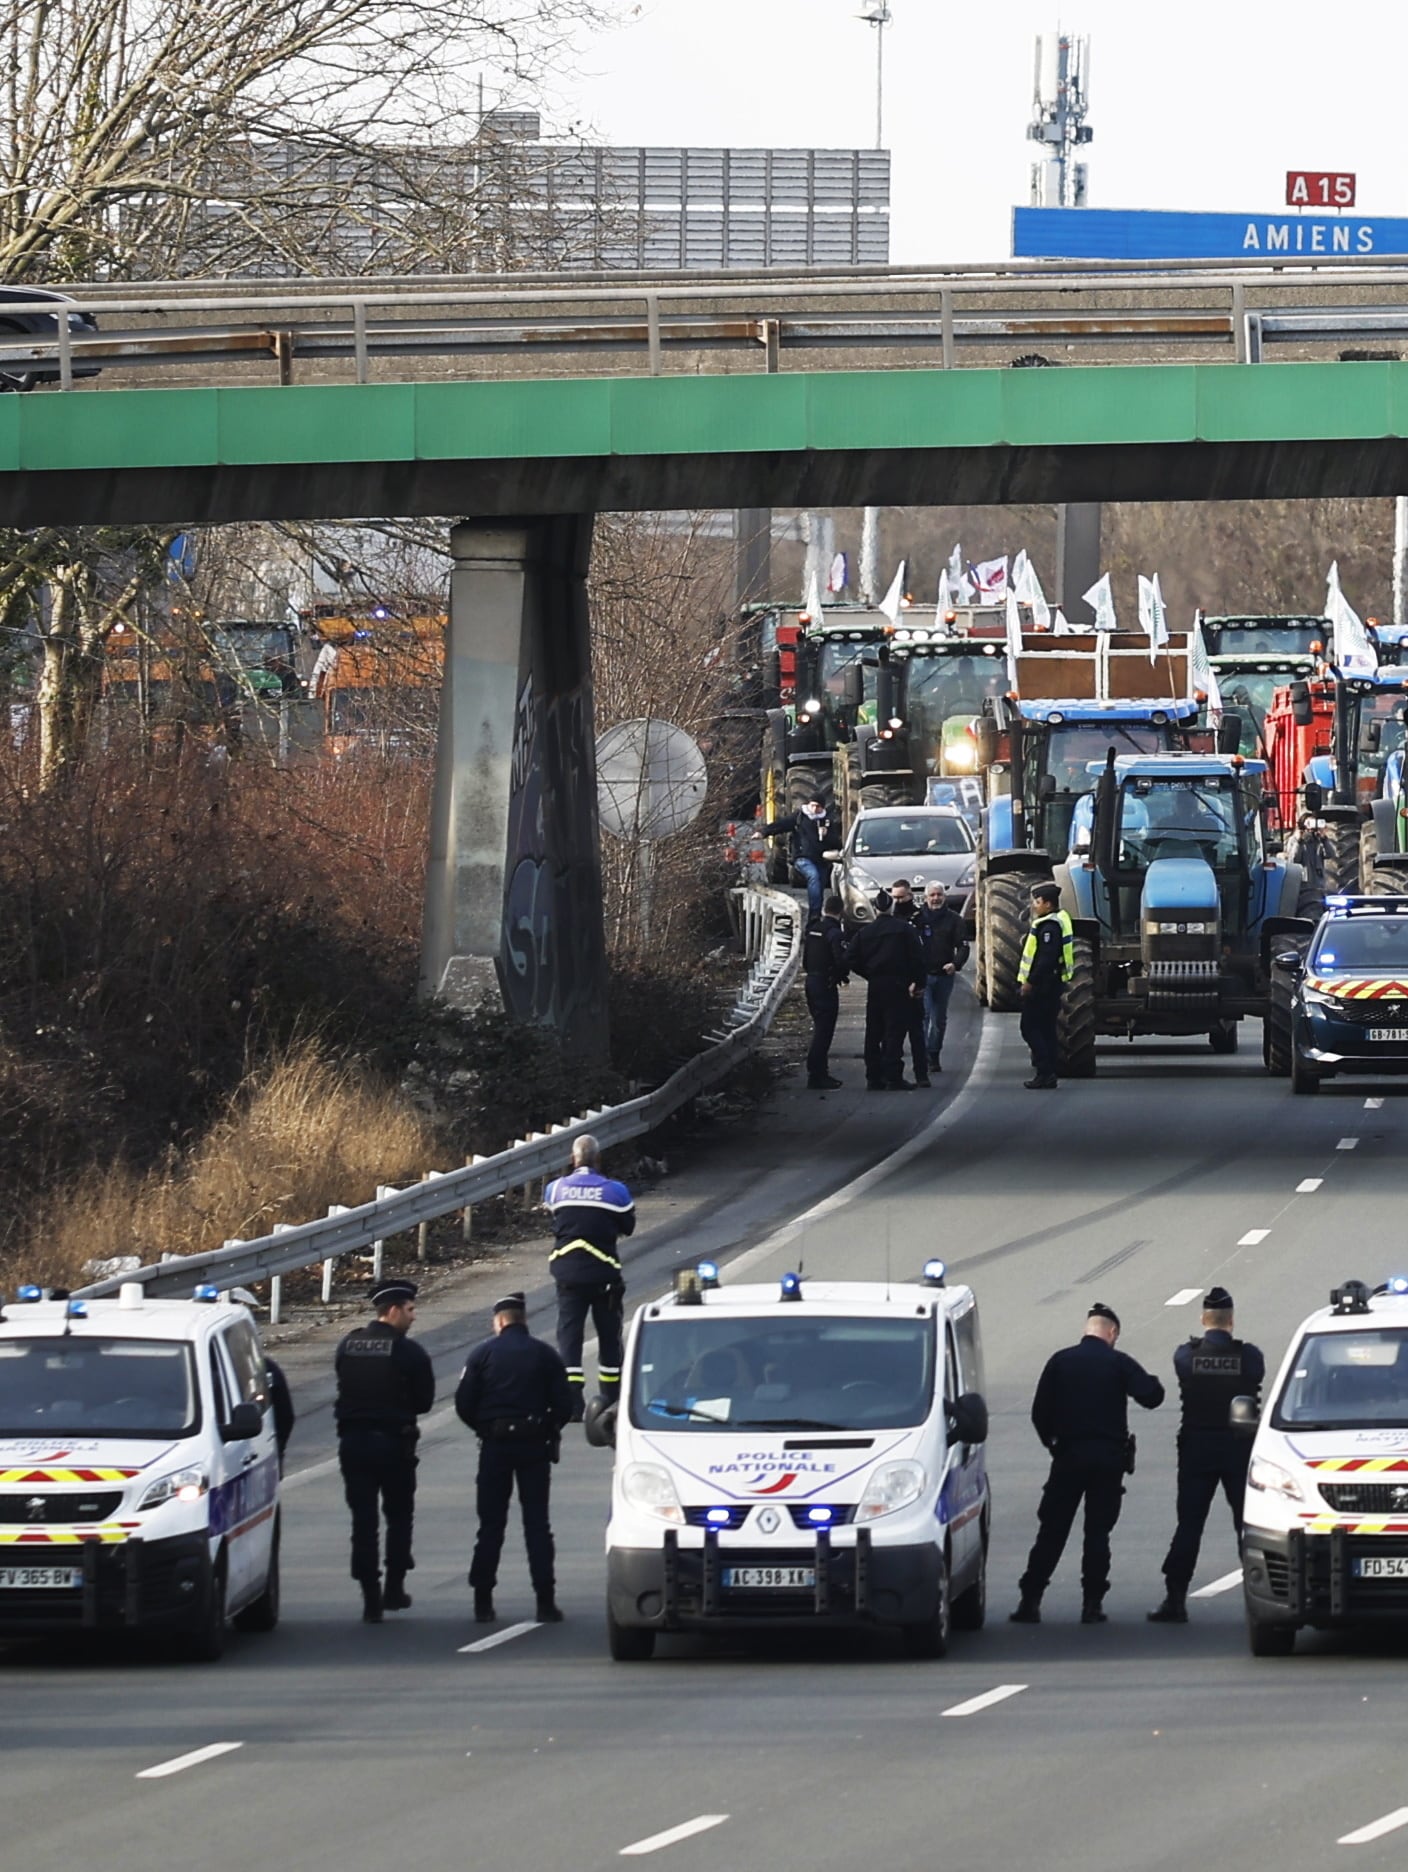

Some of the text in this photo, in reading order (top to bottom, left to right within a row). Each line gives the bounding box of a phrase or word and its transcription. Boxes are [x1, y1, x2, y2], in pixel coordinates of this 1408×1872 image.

[1291, 175, 1352, 204] A 15
[1242, 222, 1374, 253] AMIENS
[561, 1187, 604, 1200] POLICE
[347, 1340, 390, 1352] POLICE
[1194, 1358, 1240, 1370] POLICE
[736, 1451, 812, 1461] POLICE
[708, 1462, 836, 1474] NATIONALE
